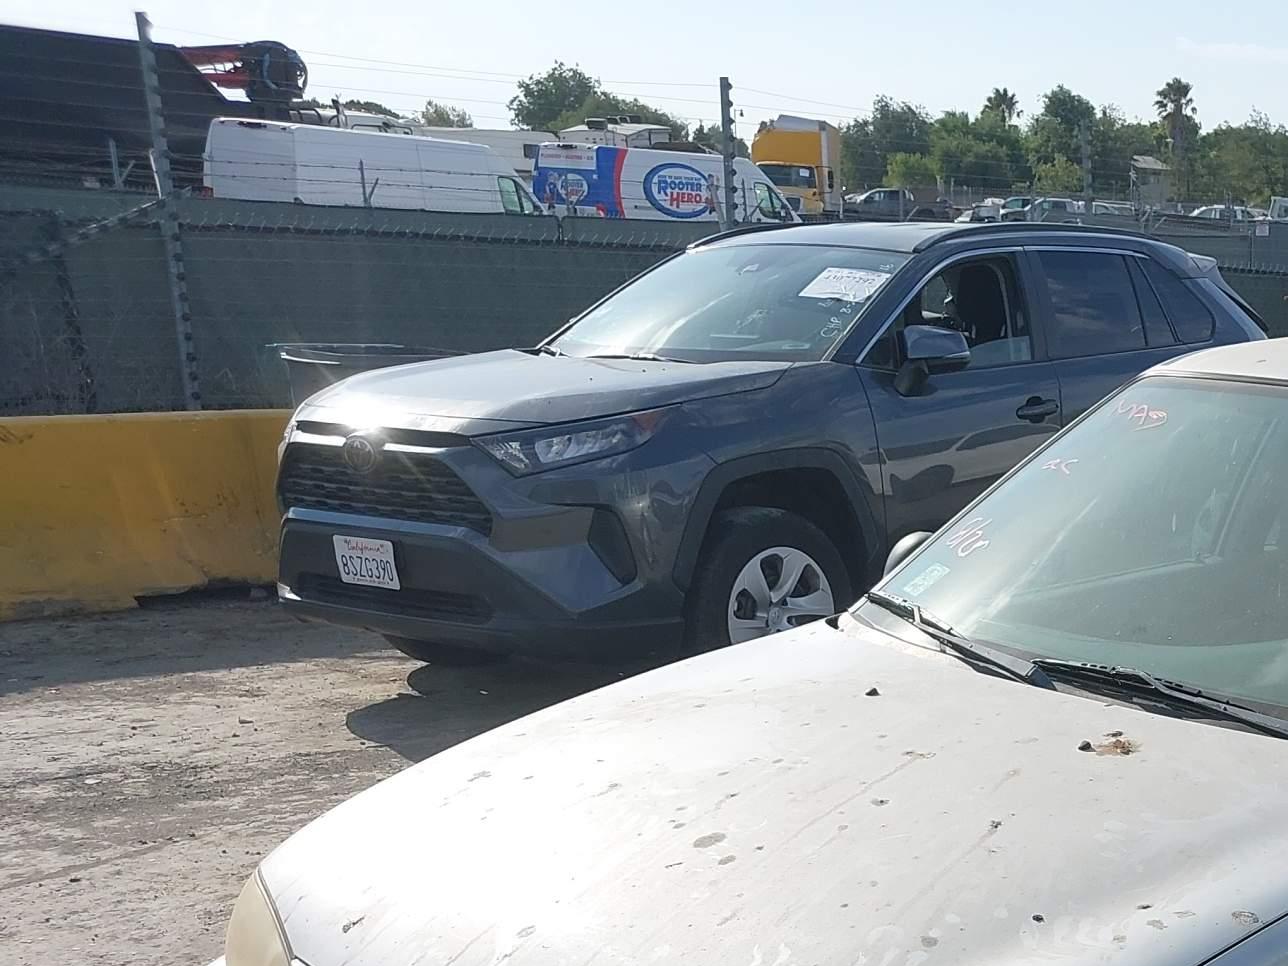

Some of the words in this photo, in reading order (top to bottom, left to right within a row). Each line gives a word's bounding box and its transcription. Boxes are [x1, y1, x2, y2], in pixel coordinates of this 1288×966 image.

[657, 179, 702, 197] ROOTER
[669, 191, 702, 209] HERO
[340, 554, 394, 582] 8SZG390
